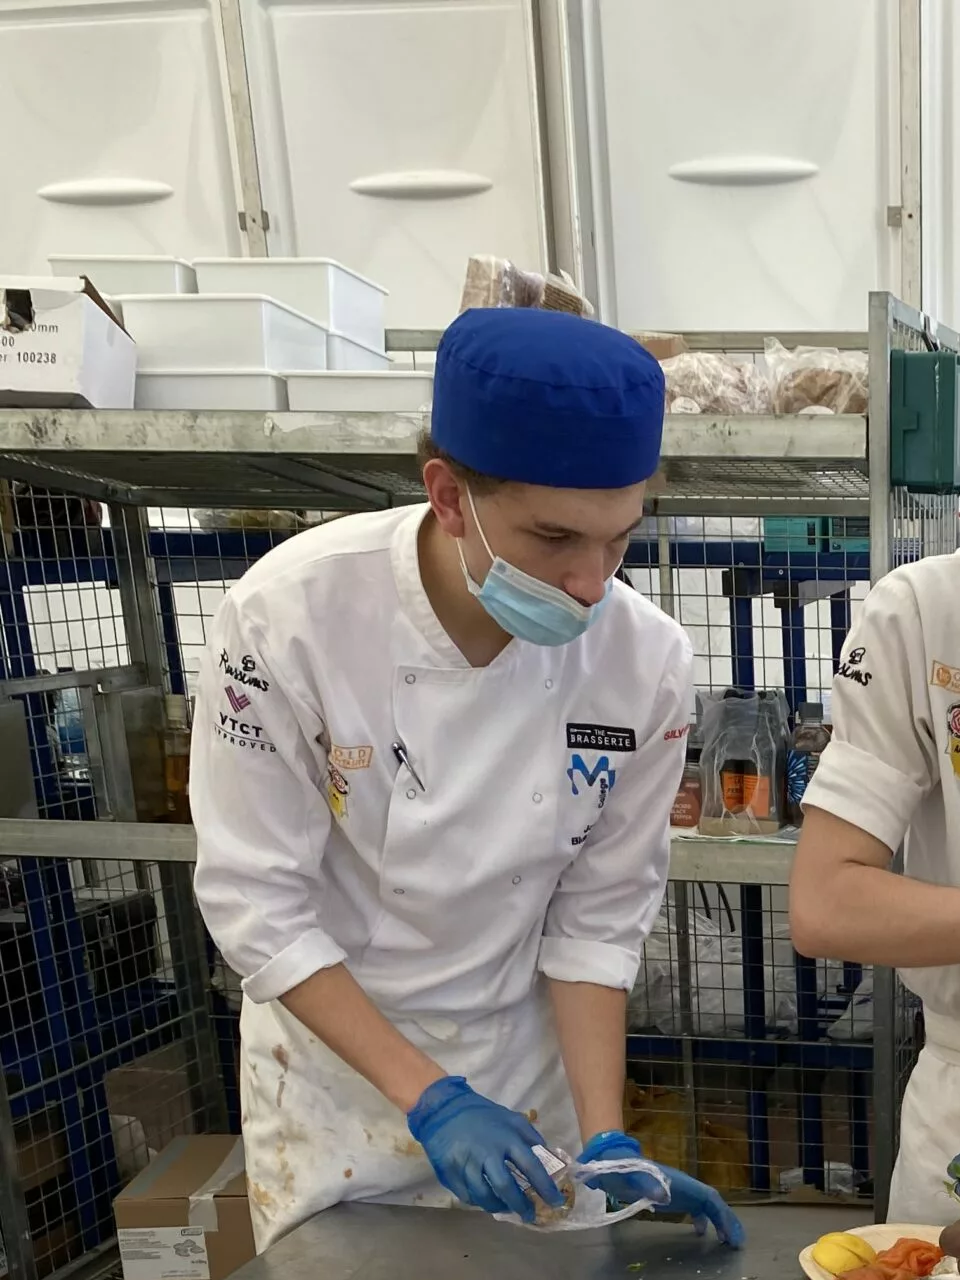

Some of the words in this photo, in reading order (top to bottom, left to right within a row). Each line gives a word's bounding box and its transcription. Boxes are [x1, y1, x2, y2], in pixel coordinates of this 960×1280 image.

[17, 352, 57, 364] 100238
[219, 711, 262, 738] VTCT
[594, 728, 606, 737] THE
[570, 734, 632, 748] BRASSERIE
